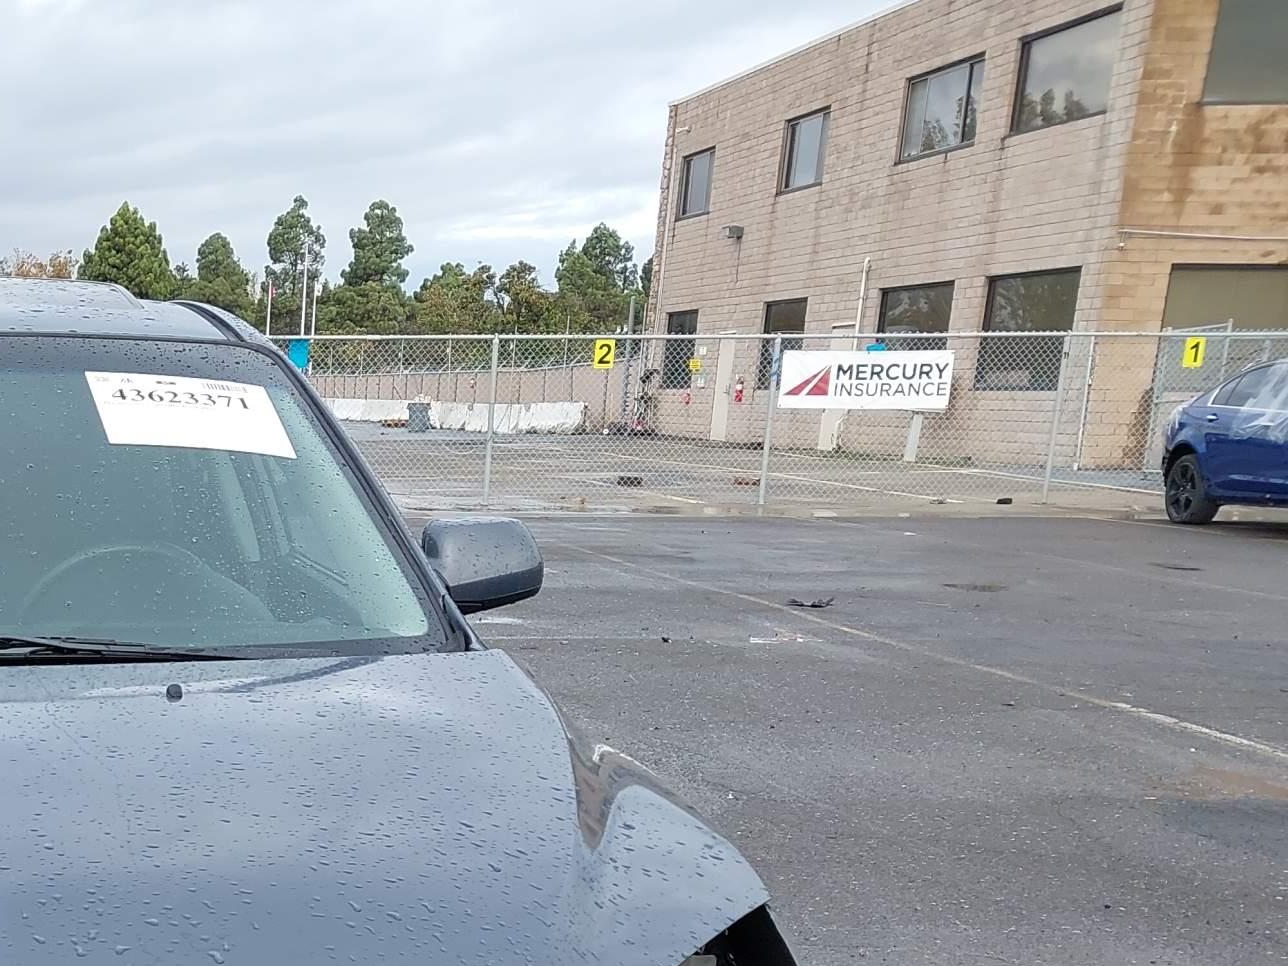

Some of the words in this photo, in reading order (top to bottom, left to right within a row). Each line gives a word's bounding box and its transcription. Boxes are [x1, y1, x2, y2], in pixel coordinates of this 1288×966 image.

[597, 343, 612, 365] 2
[1190, 341, 1201, 363] 1
[836, 362, 949, 381] MERCURY
[111, 387, 250, 410] 43623371
[834, 382, 948, 397] INSURANCE
